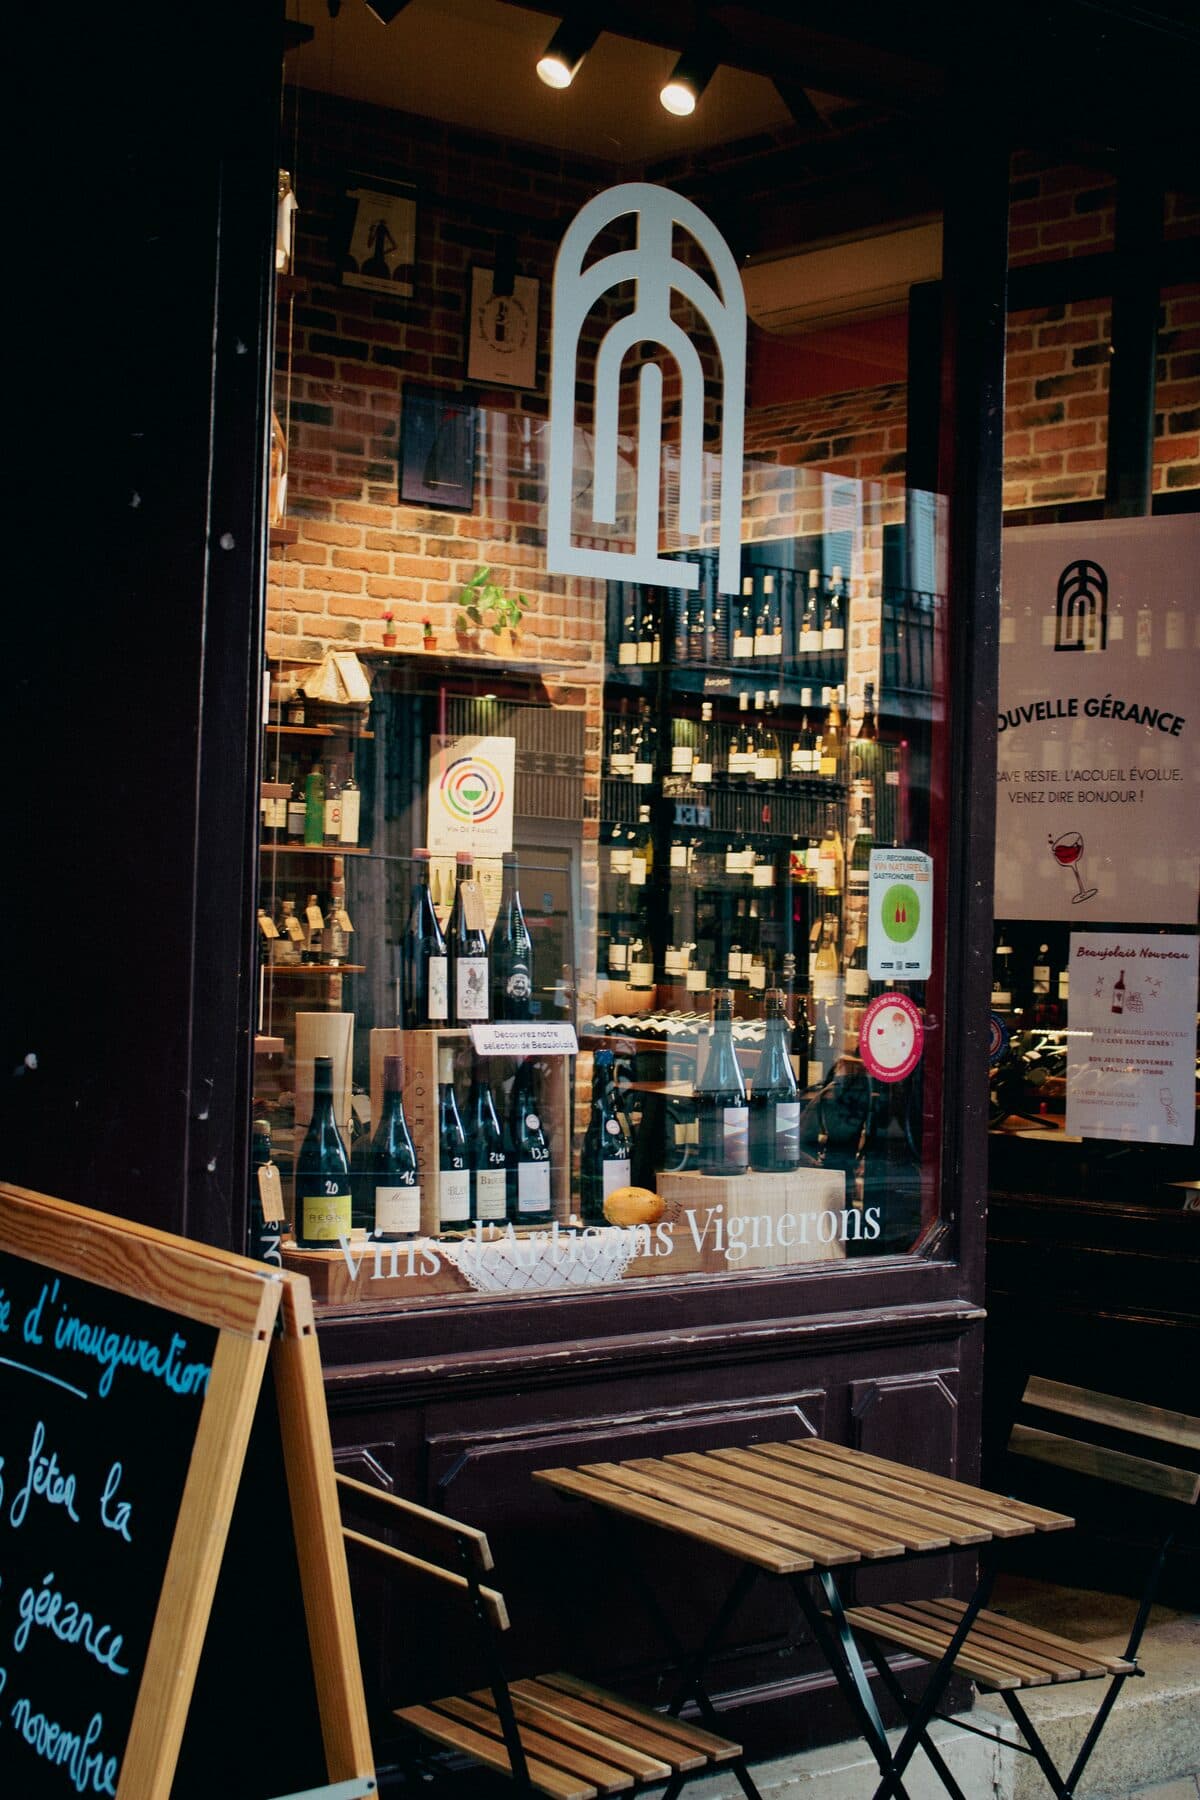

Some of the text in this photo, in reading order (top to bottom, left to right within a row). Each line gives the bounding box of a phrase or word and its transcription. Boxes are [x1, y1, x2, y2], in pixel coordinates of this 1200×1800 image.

[1084, 694, 1186, 737] GÉRANCE
[1065, 769, 1126, 782] L'ACCUEIL
[1130, 766, 1184, 782] ÉVOLUE.
[1008, 791, 1045, 804] VENEZ
[1049, 791, 1075, 803] DIRE
[1078, 790, 1136, 803] BONJOUR
[889, 862, 921, 872] NATUREL
[873, 872, 915, 881] GASTRONOMIE
[1076, 946, 1191, 961] Beaujolais Nouveau
[453, 1156, 463, 1168] 21
[400, 1170, 415, 1185] 16
[325, 1180, 339, 1194] 20
[338, 1226, 442, 1282] Vins
[459, 1218, 674, 1271] d'Artisans
[686, 1203, 882, 1261] Vignerons
[23, 1278, 212, 1398] d'inauguration
[100, 1461, 132, 1542] la
[14, 1572, 129, 1675] gérance
[11, 1698, 118, 1797] novembre
